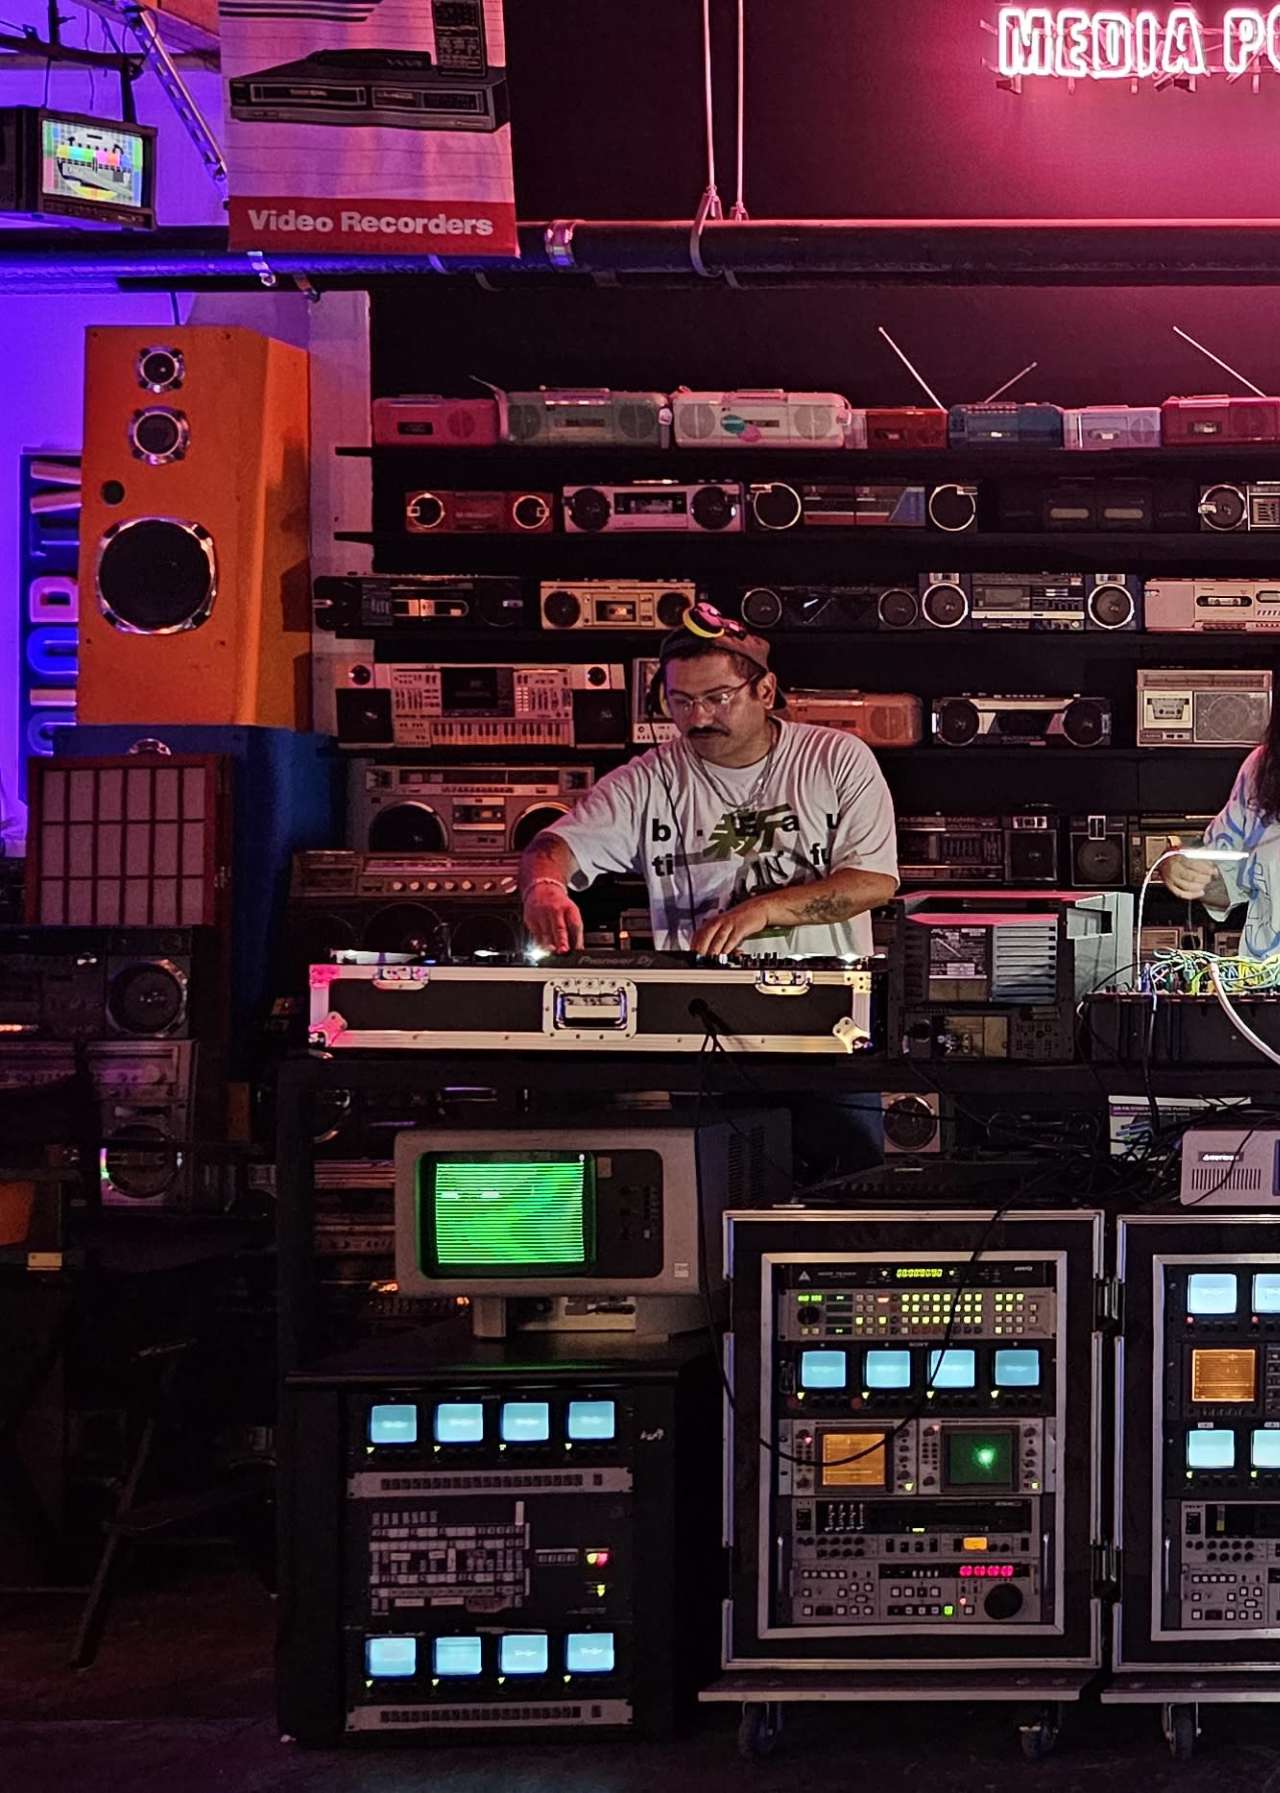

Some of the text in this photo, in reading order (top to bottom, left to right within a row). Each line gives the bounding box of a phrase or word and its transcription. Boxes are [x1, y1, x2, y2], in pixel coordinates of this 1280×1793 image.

[997, 8, 1208, 80] MEDIA
[248, 208, 494, 236] Video Recorders
